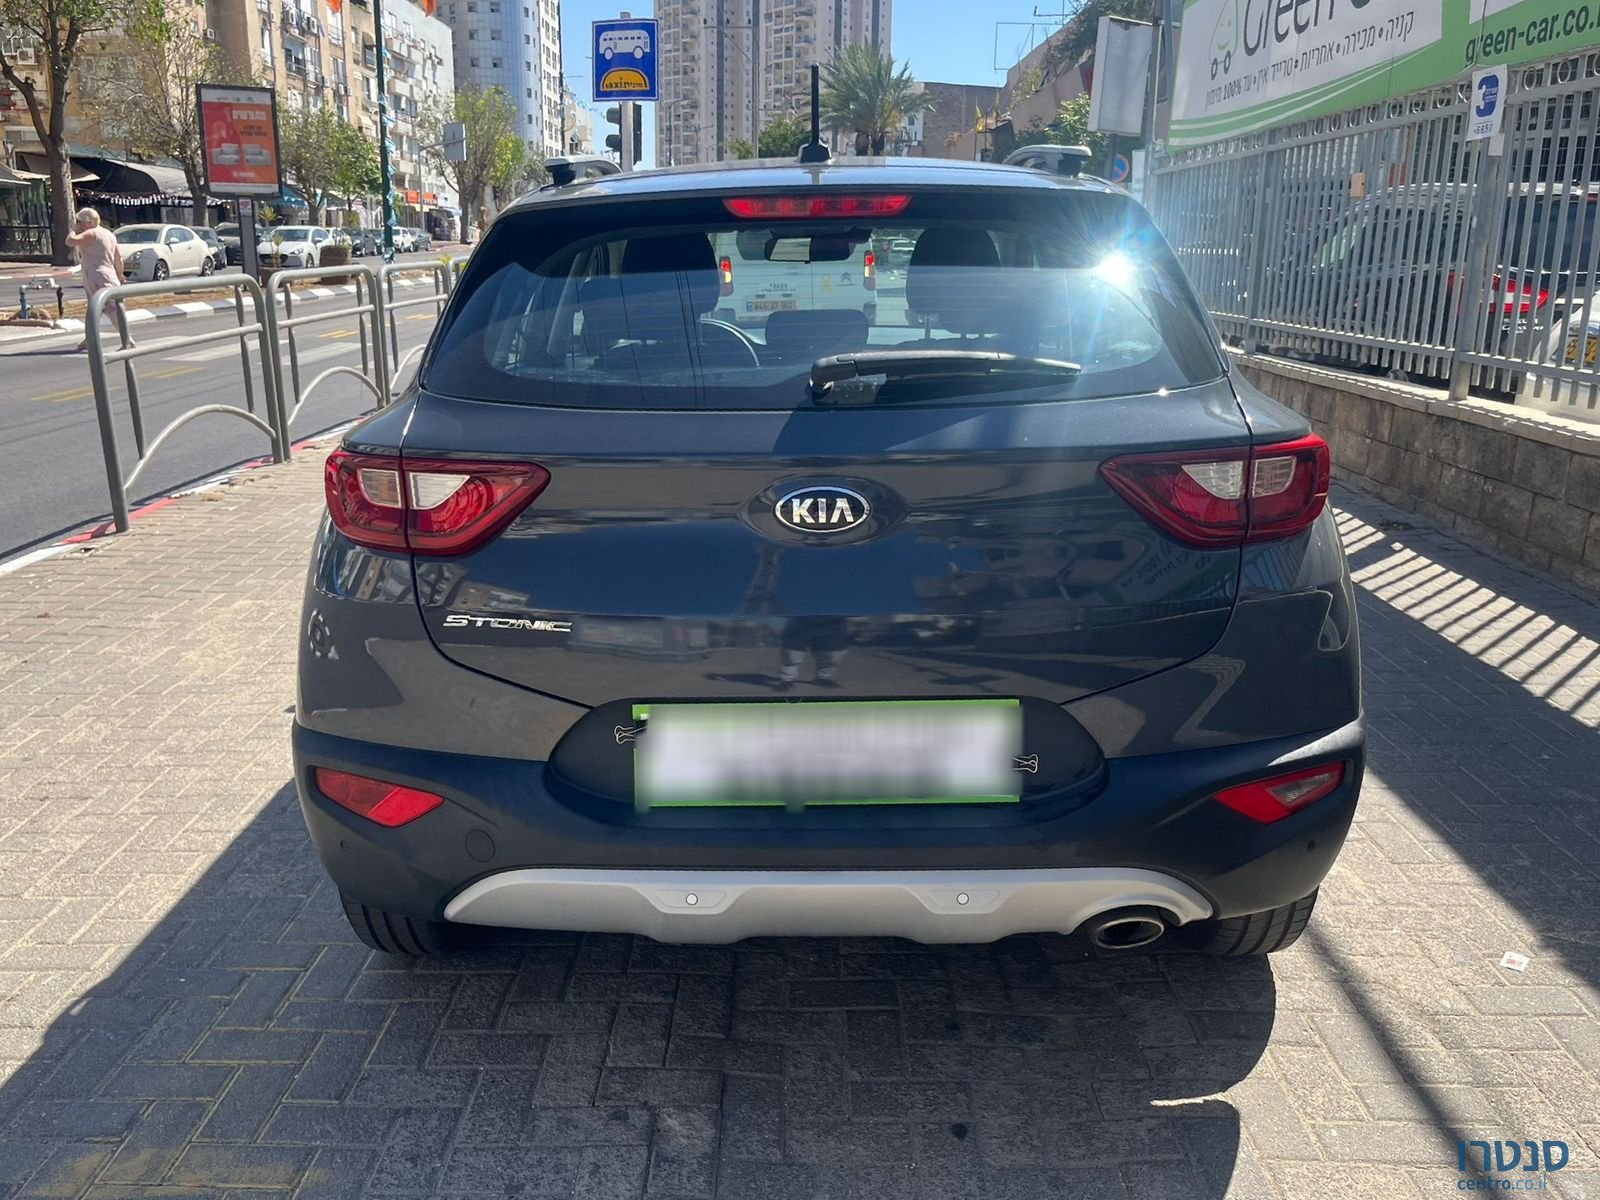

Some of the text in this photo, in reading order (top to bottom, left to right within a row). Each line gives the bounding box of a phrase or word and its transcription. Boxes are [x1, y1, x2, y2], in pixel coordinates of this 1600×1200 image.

[1385, 11, 1415, 42] קניה
[1342, 25, 1376, 56] מכירה
[1271, 57, 1293, 81] טרייד
[1299, 41, 1335, 73] אחריות
[605, 77, 623, 88] taxi
[1223, 79, 1241, 100] 100%
[791, 498, 855, 523] KIA
[443, 615, 573, 632] STONIC
